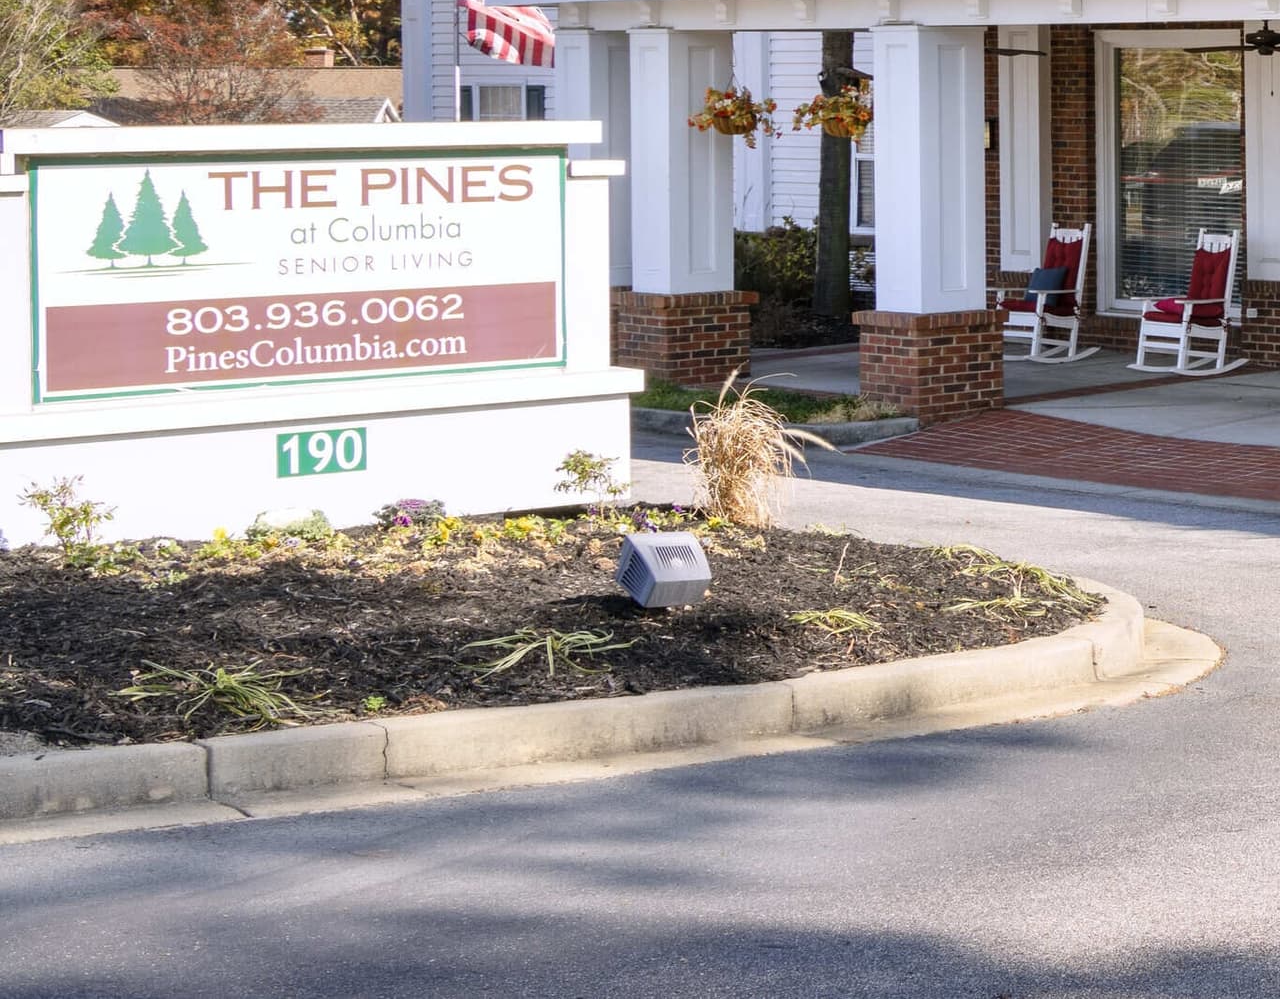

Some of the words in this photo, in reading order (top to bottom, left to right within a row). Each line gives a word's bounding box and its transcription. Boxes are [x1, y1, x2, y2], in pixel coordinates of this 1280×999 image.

[208, 170, 336, 210] THE
[361, 165, 533, 206] PINES
[290, 222, 317, 245] at
[328, 212, 461, 243] Columbia
[278, 255, 374, 276] SENIOR
[391, 250, 473, 271] LIVING
[166, 294, 465, 336] 803.936.0062
[164, 332, 467, 374] PinesColumbia.com
[281, 429, 363, 475] 190
